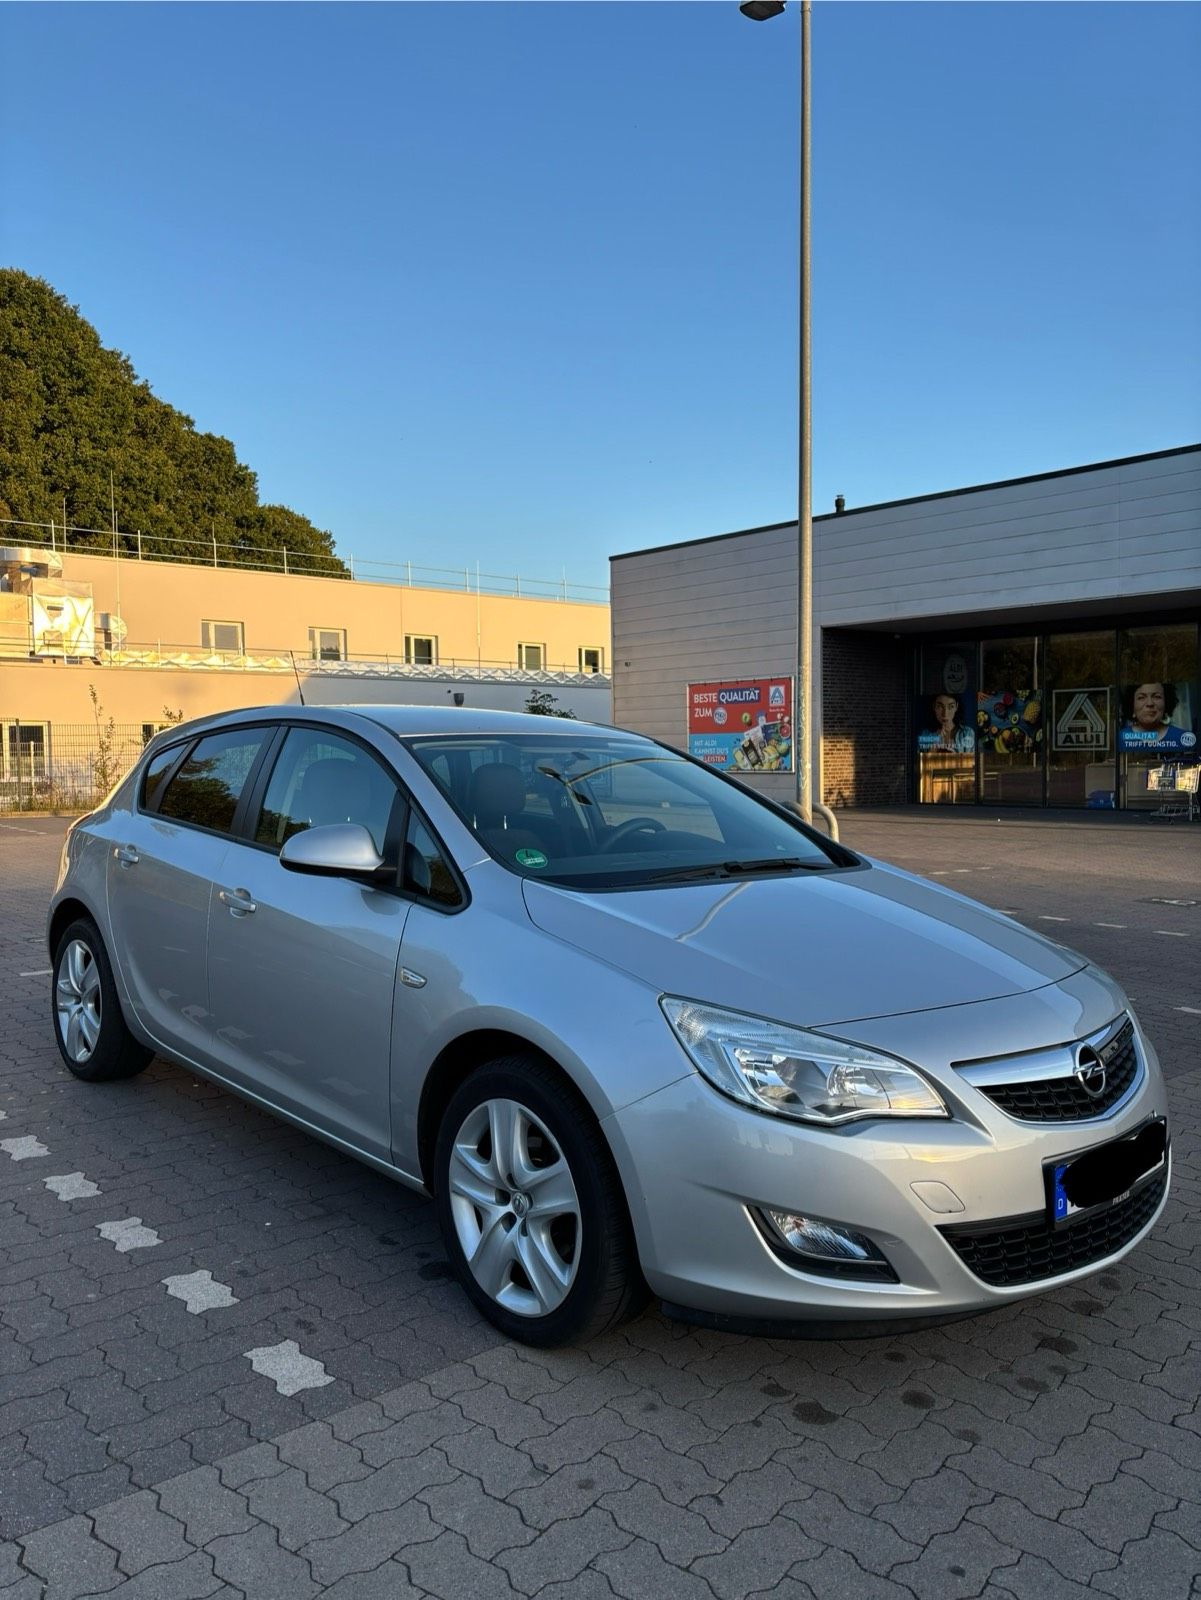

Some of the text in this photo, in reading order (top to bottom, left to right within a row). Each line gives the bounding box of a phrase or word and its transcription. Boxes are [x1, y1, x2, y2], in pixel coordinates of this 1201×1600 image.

[694, 688, 759, 704] BESTE QUALITÄT
[694, 708, 713, 717] ZUM
[1063, 734, 1100, 744] ALDI
[1058, 1198, 1063, 1209] D
